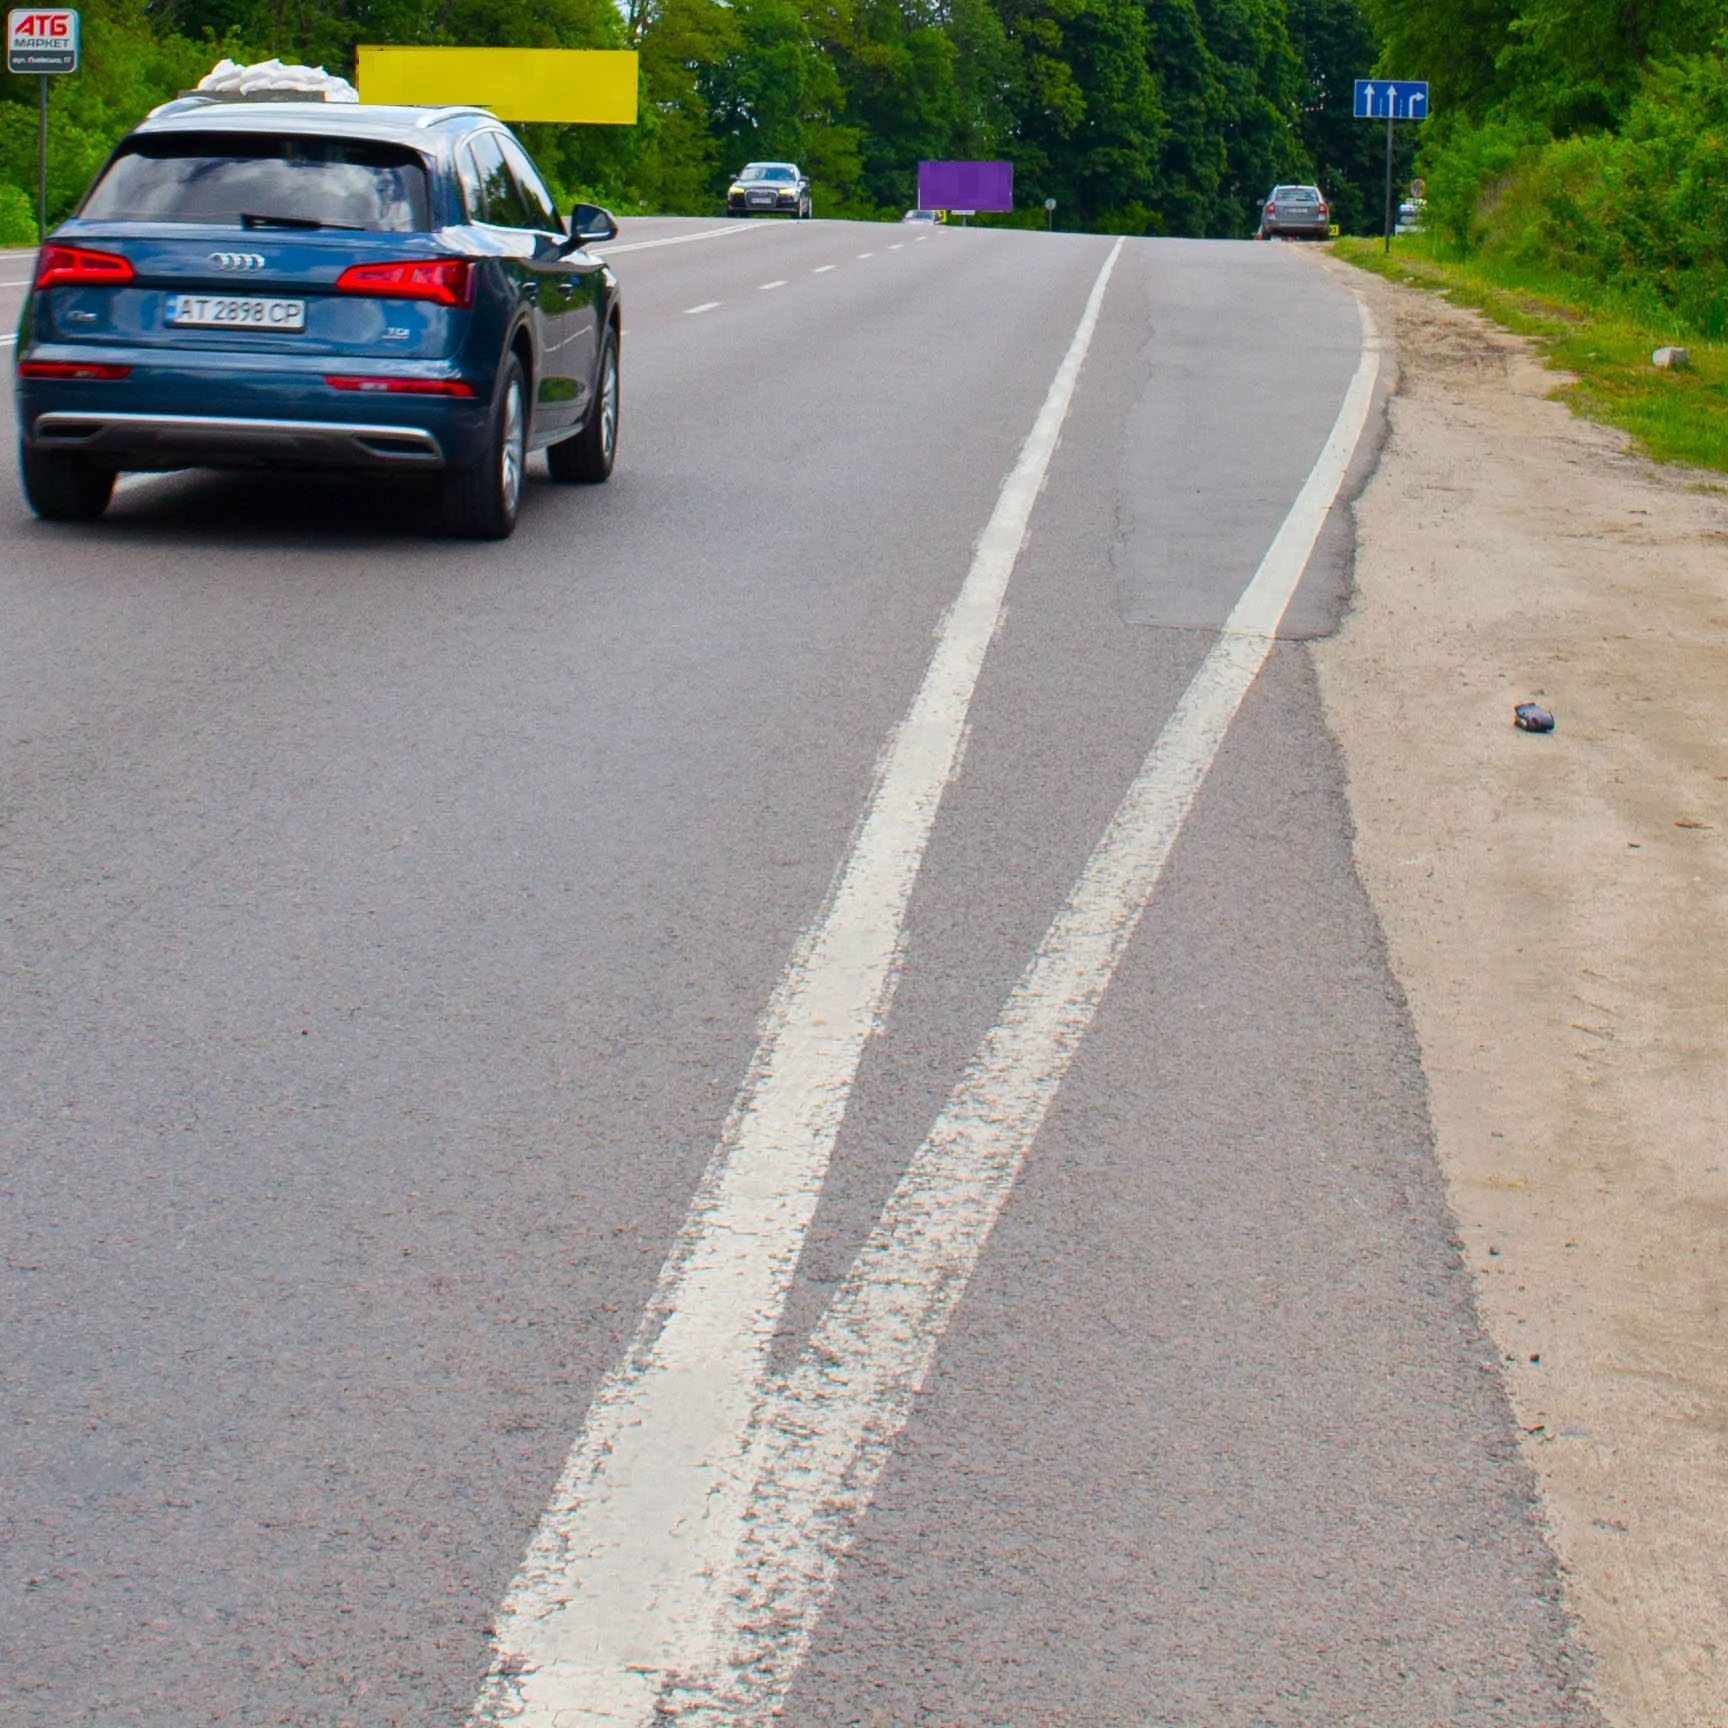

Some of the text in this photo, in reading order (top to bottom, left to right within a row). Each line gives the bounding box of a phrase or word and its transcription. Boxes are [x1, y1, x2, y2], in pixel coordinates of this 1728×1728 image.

[15, 15, 70, 37] АТБ
[15, 38, 70, 49] МАРКЕТ
[180, 299, 301, 323] AT 2898 CP
